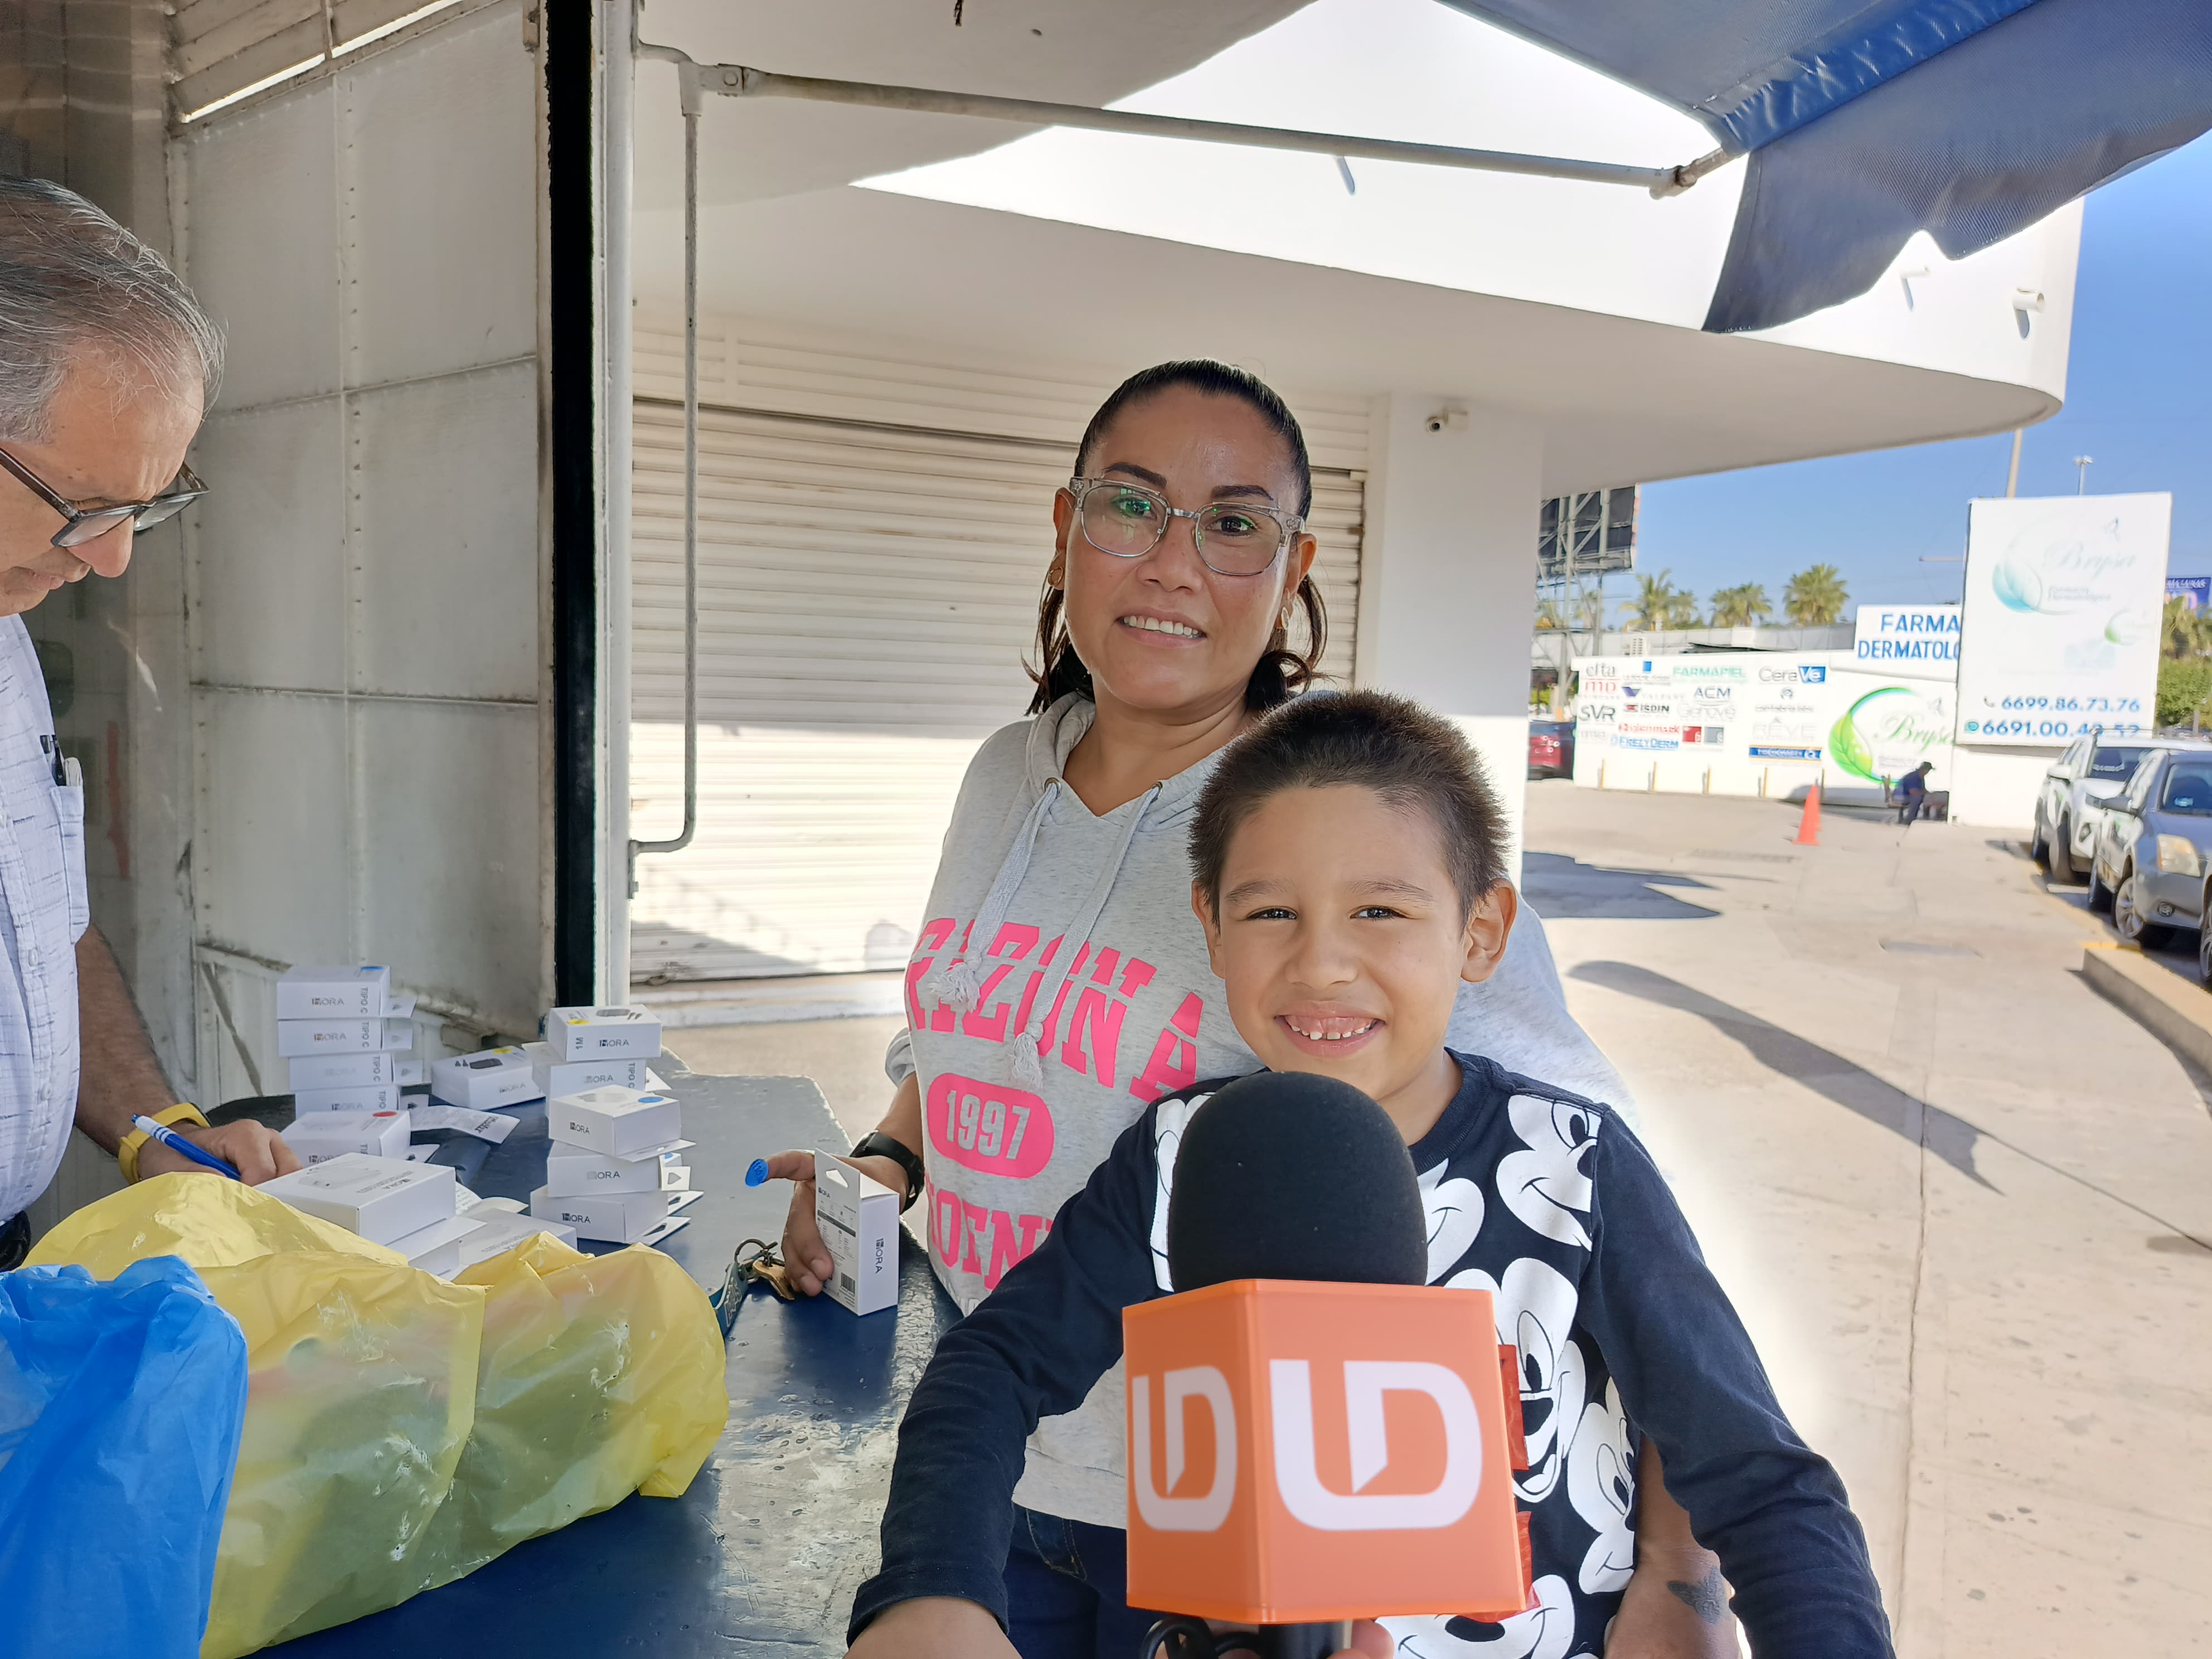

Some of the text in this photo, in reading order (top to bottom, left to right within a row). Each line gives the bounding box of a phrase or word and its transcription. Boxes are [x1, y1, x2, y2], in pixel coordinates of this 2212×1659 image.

[1881, 614, 1960, 632] FARMA
[1694, 686, 1731, 699] ACM
[1580, 705, 1616, 722] SVR
[945, 1089, 1031, 1161] 1997
